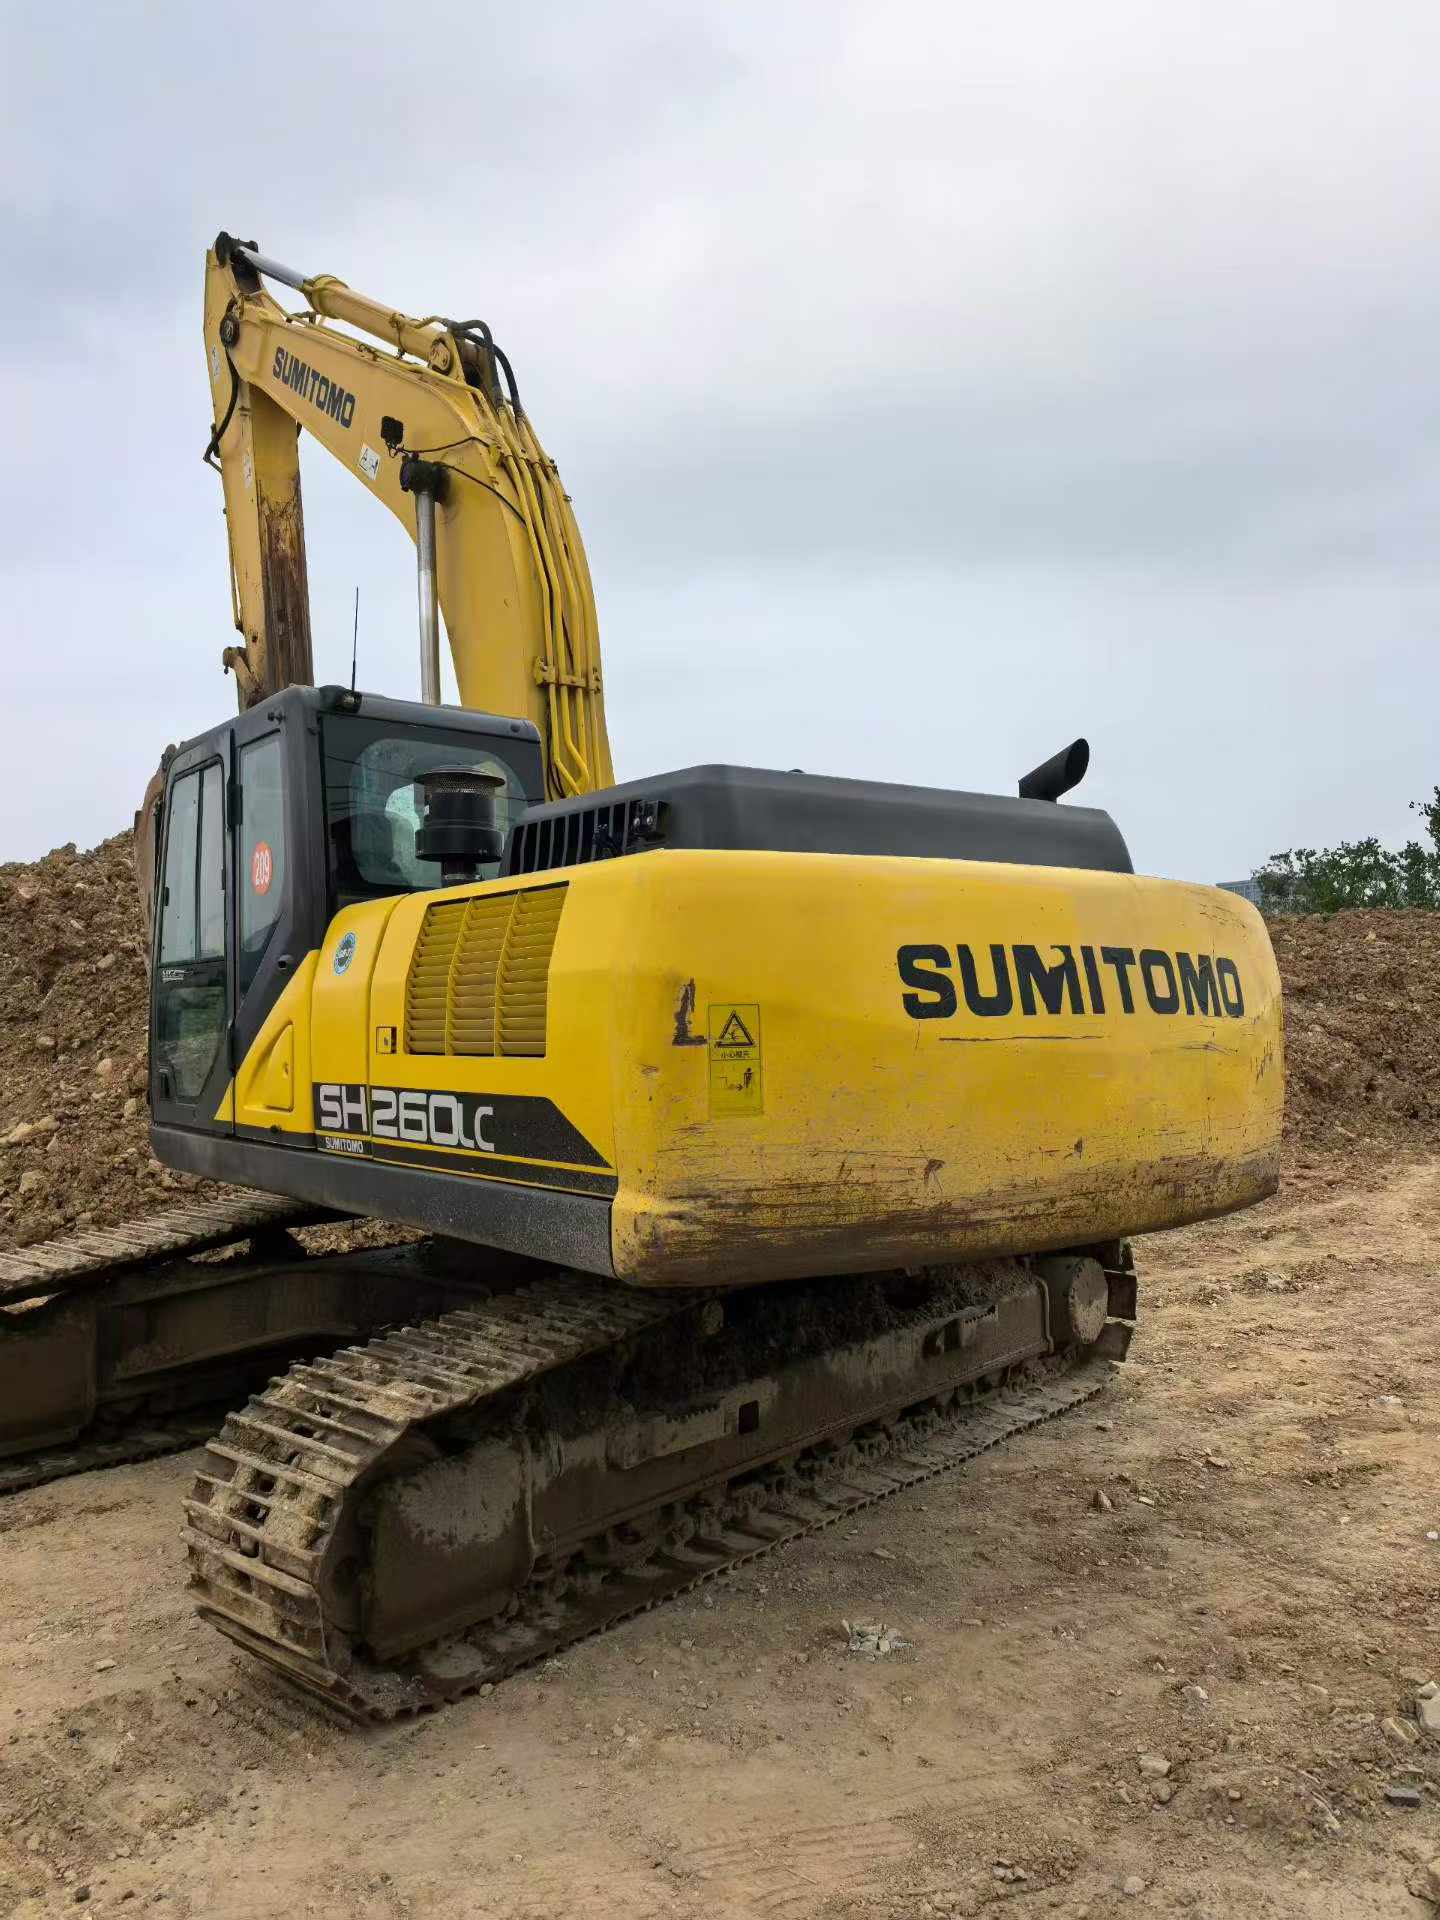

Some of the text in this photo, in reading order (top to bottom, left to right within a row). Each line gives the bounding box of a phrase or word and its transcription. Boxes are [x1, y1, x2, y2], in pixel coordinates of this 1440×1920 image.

[273, 346, 356, 428] SUMITOMO
[897, 944, 1244, 1018] SUMITOMO
[319, 1084, 495, 1152] SH260LC
[325, 1136, 364, 1153] SUMITOMO
